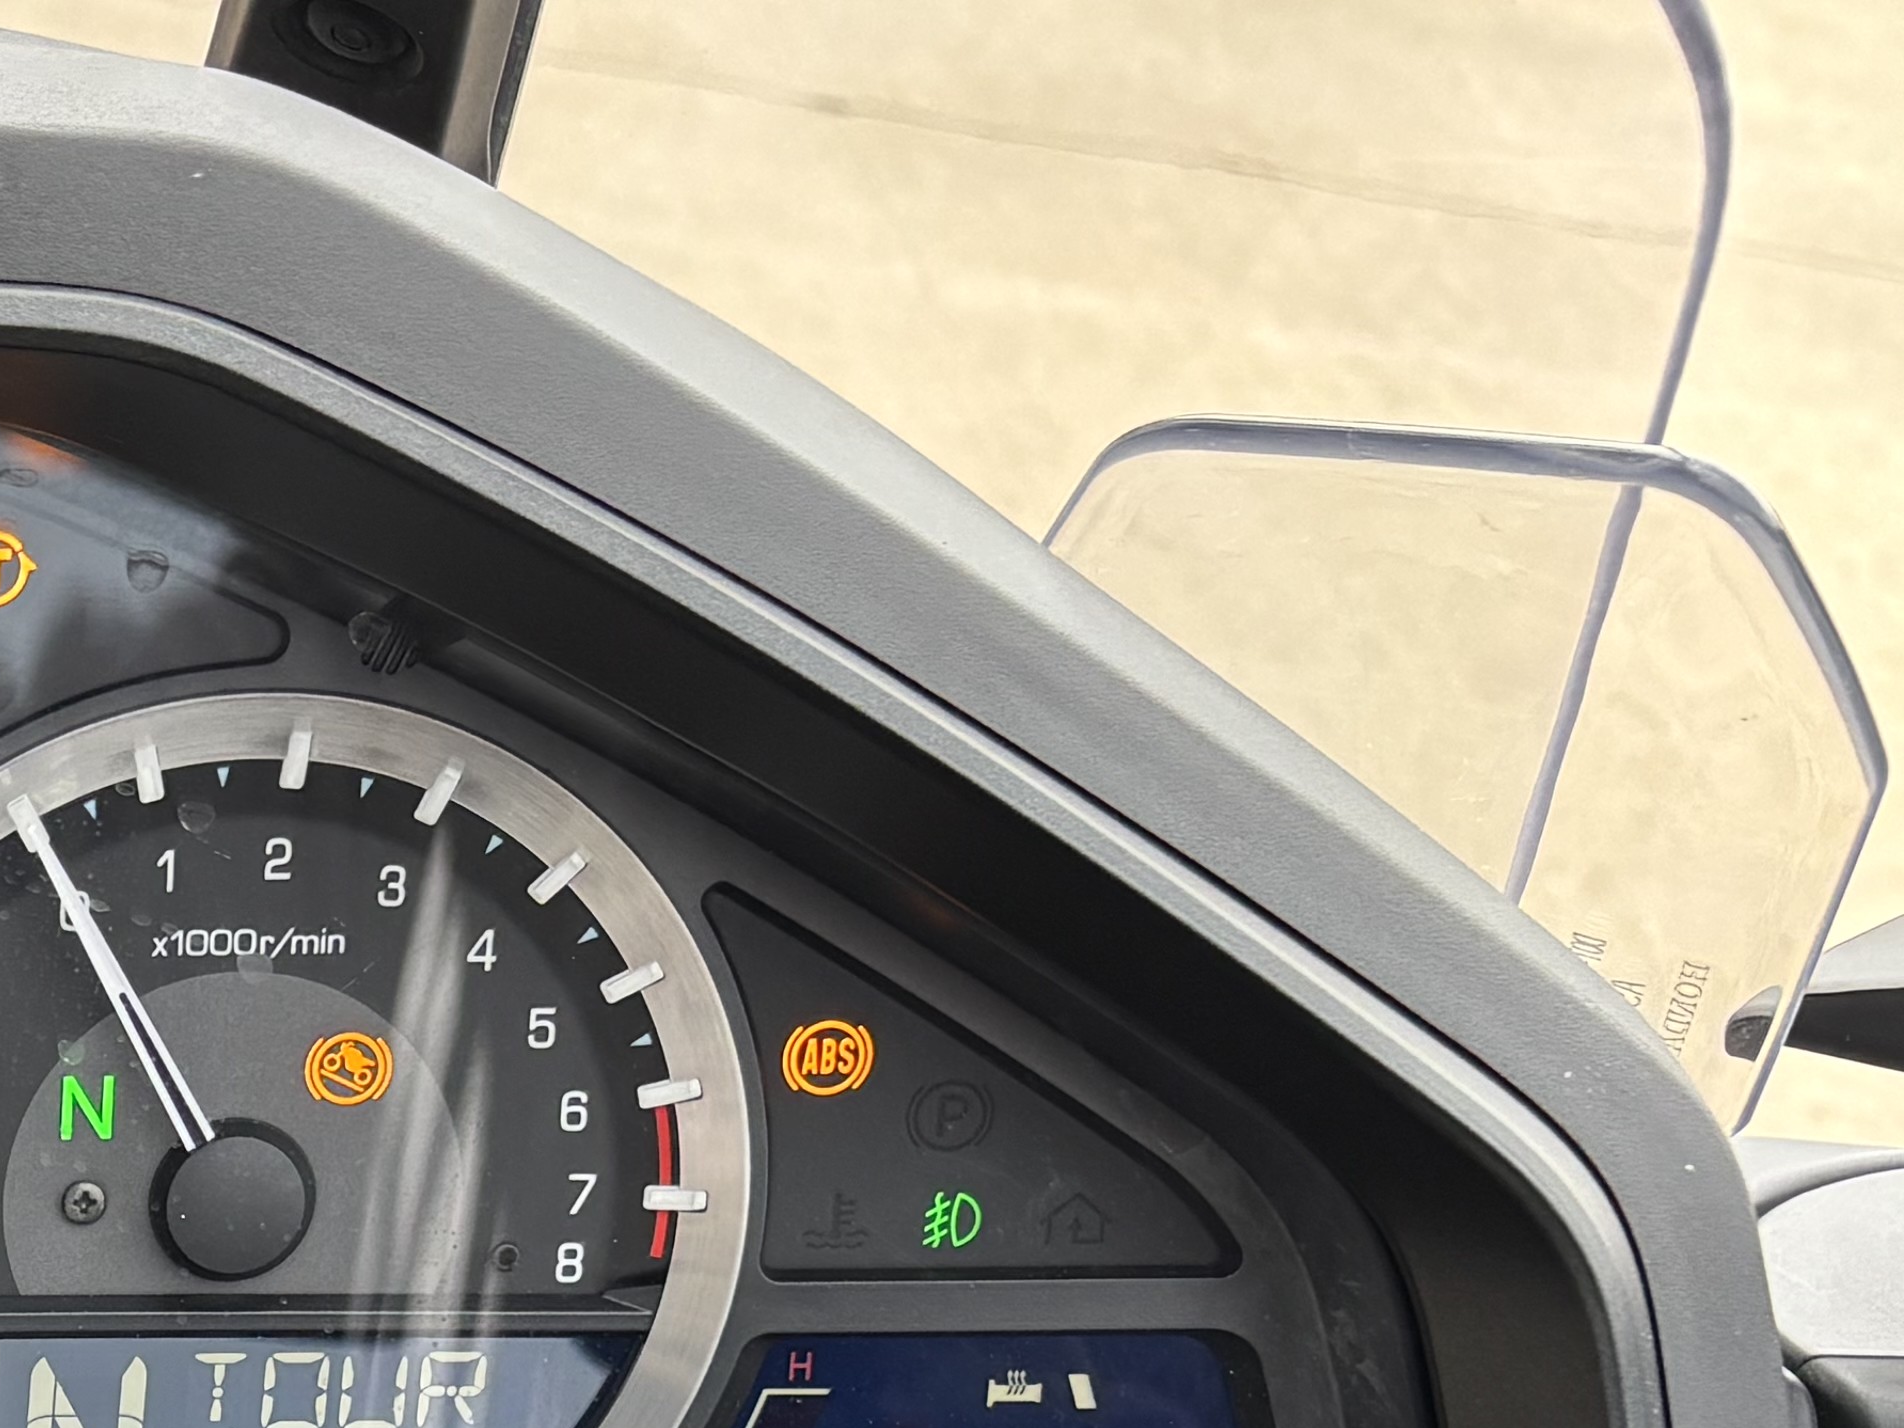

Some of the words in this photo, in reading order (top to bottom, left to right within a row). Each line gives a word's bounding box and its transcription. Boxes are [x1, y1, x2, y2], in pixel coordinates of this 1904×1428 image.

[157, 850, 174, 892] 1
[264, 838, 292, 880] 2
[378, 865, 406, 907] 3
[151, 928, 346, 958] x1000r/min
[467, 929, 497, 971] 4
[528, 1007, 556, 1048] 5
[802, 1038, 855, 1075] ABS
[60, 1075, 114, 1140] N
[560, 1091, 588, 1131] 6
[569, 1174, 597, 1214] 7
[556, 1243, 584, 1283] 8
[789, 1352, 812, 1380] H
